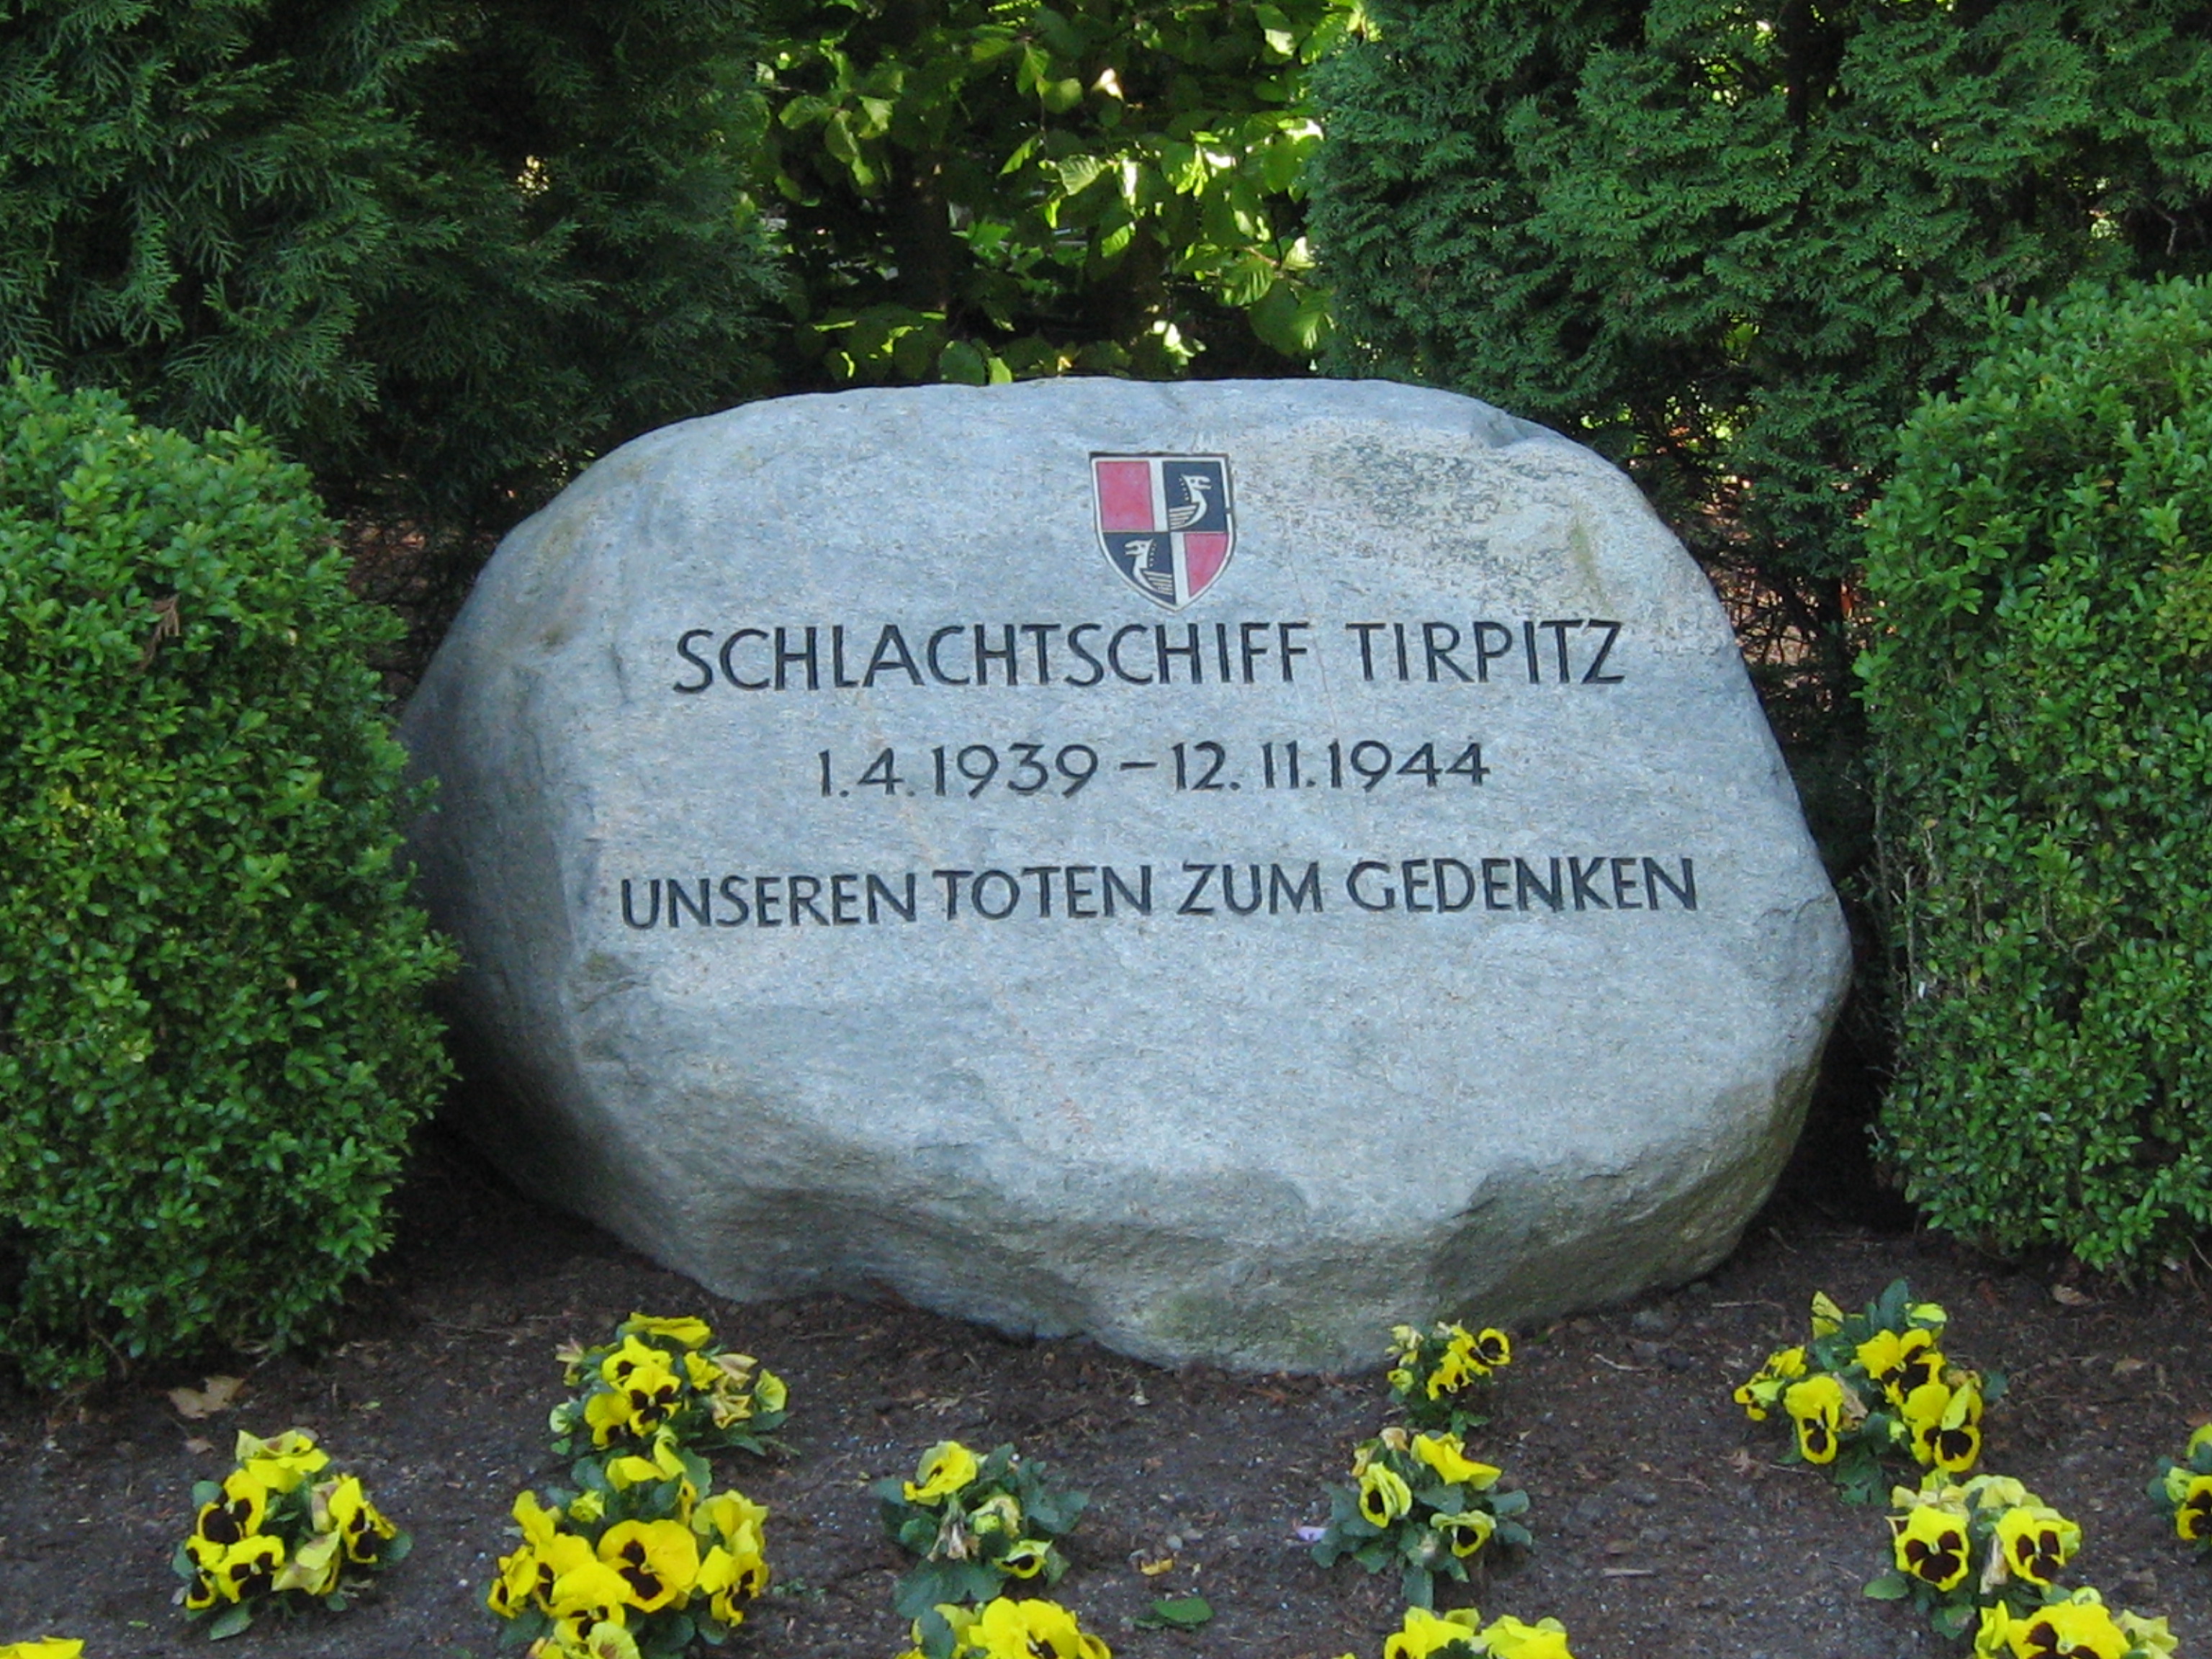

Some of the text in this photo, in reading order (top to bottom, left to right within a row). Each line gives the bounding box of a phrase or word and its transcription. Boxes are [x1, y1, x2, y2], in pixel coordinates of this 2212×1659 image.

[672, 618, 1625, 693] SCHLACHTSCHIFF TIRPITZ
[621, 855, 1697, 930] UNSEREN TOTEN ZUM GEDENKEN
